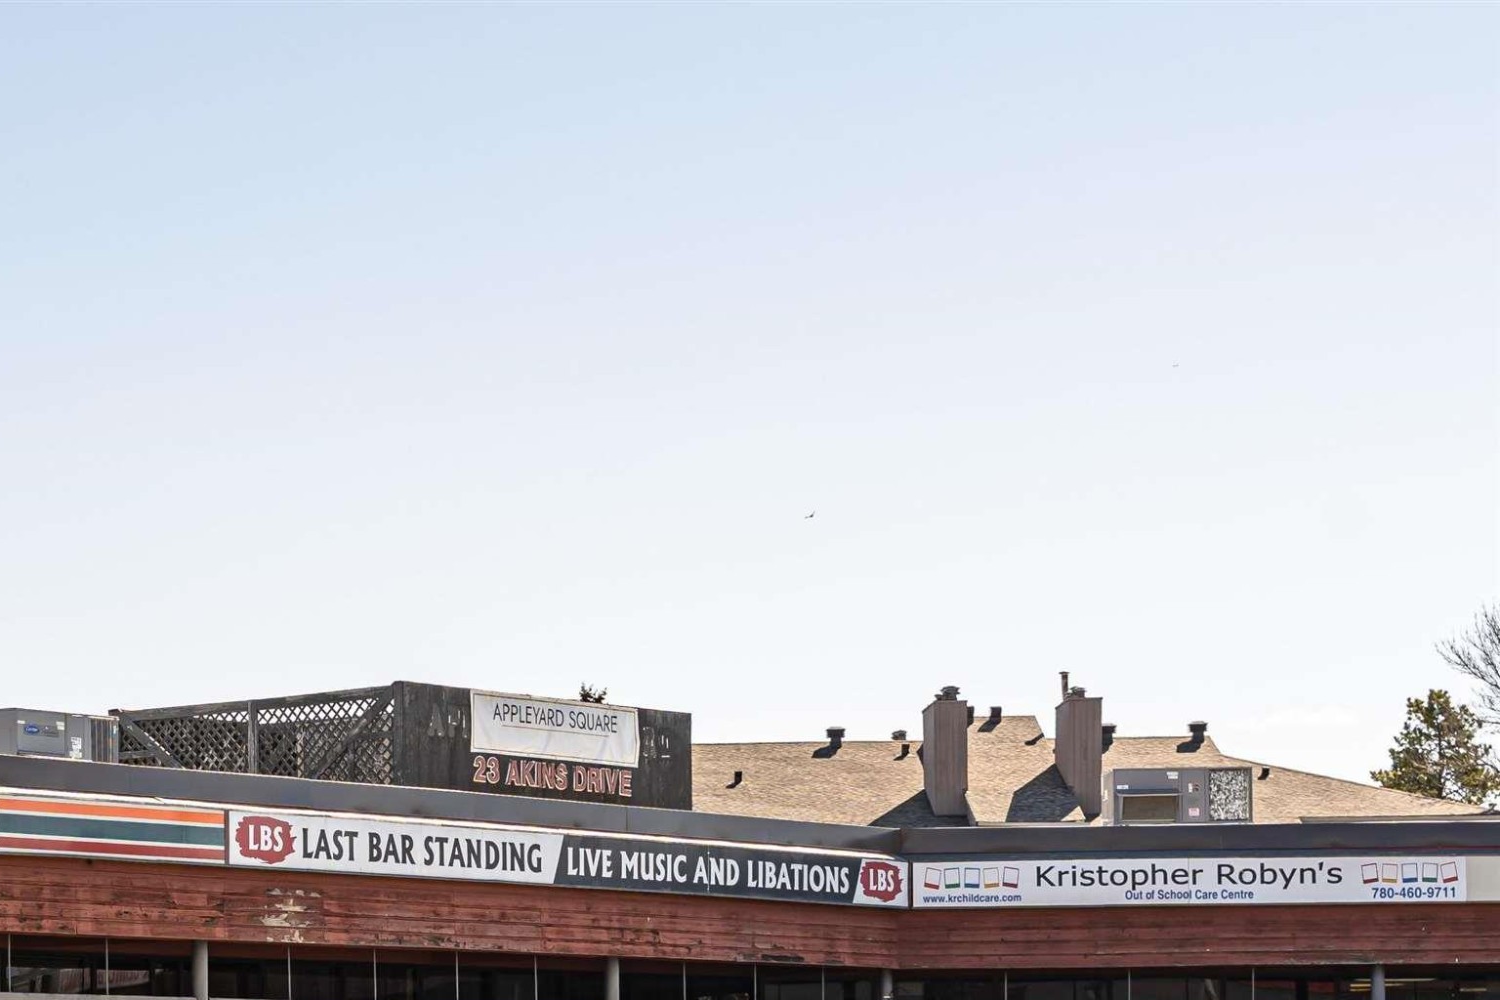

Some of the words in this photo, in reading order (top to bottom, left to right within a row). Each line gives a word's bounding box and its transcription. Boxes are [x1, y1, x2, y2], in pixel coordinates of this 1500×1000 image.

[492, 703, 565, 727] APPLEYARD
[569, 711, 618, 733] SQUARE
[473, 755, 501, 784] 23
[505, 759, 568, 791] AKINS
[573, 765, 632, 797] DRIVE
[248, 824, 285, 852] LBS
[302, 828, 358, 861] LAST
[368, 832, 416, 864] BAR
[424, 836, 542, 873] STANDING
[567, 847, 613, 878] LIVE
[620, 850, 687, 883] MUSIC
[693, 856, 740, 886] AND
[747, 860, 849, 893] LIBATIONS
[869, 868, 895, 892] LBS
[1036, 864, 1203, 890] Kristopher
[1217, 862, 1342, 889] Robyn's
[923, 894, 1022, 903] www.krchildcare.com
[1125, 890, 1144, 900] Out
[1146, 890, 1155, 900] of
[1157, 889, 1192, 899] School
[1195, 889, 1218, 899] Care
[1221, 889, 1254, 899] Centre
[1371, 887, 1457, 899] 780-460-9711
